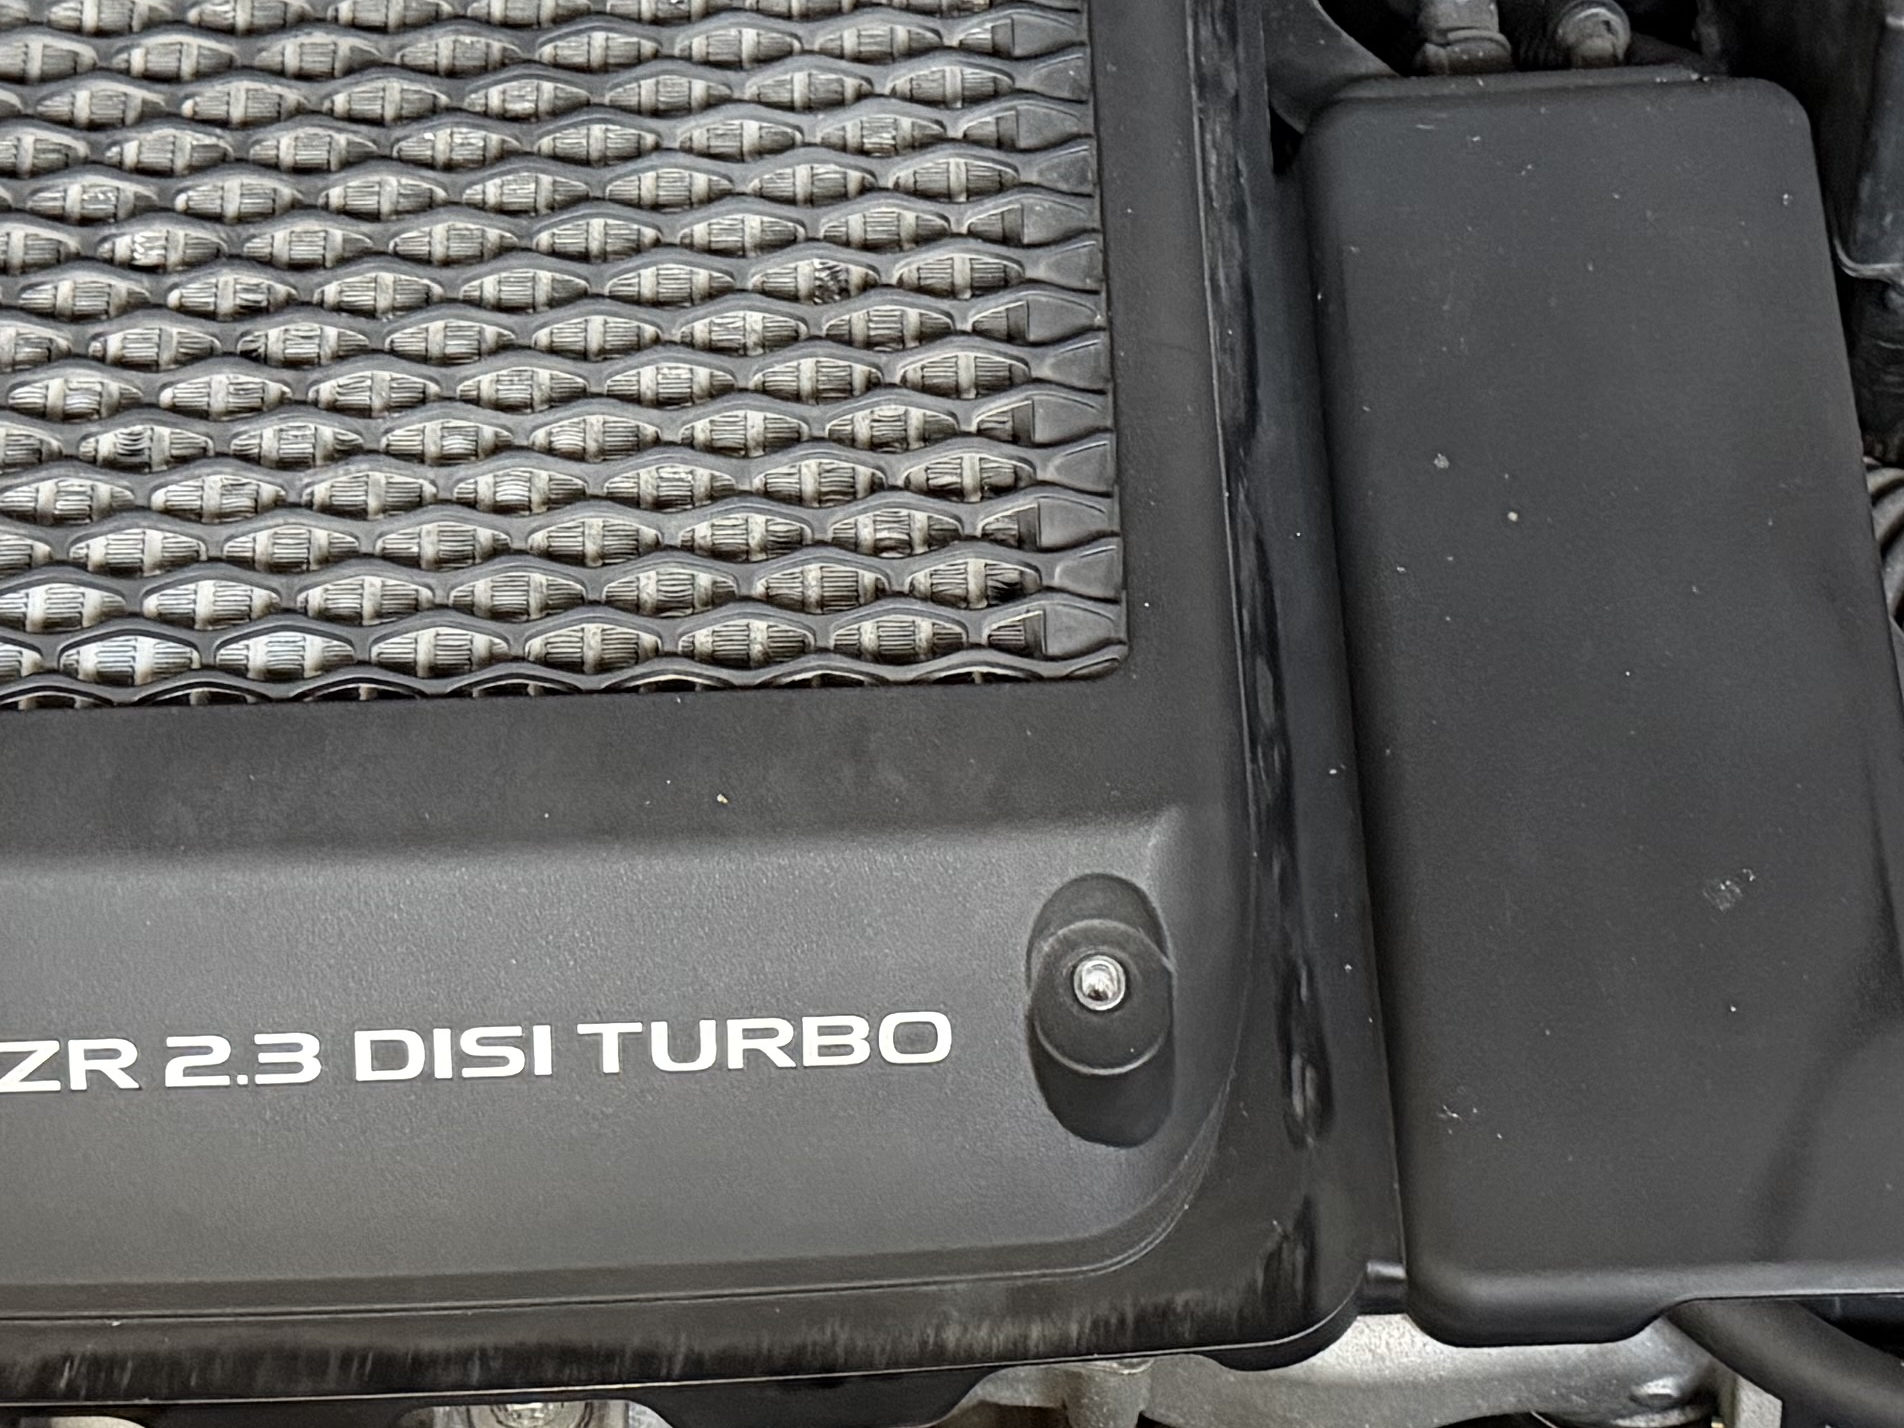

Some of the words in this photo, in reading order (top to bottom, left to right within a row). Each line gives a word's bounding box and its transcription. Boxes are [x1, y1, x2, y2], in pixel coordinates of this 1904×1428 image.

[162, 1032, 323, 1090] 2.3
[352, 1024, 555, 1084] DISI
[576, 1009, 955, 1075] TURBO
